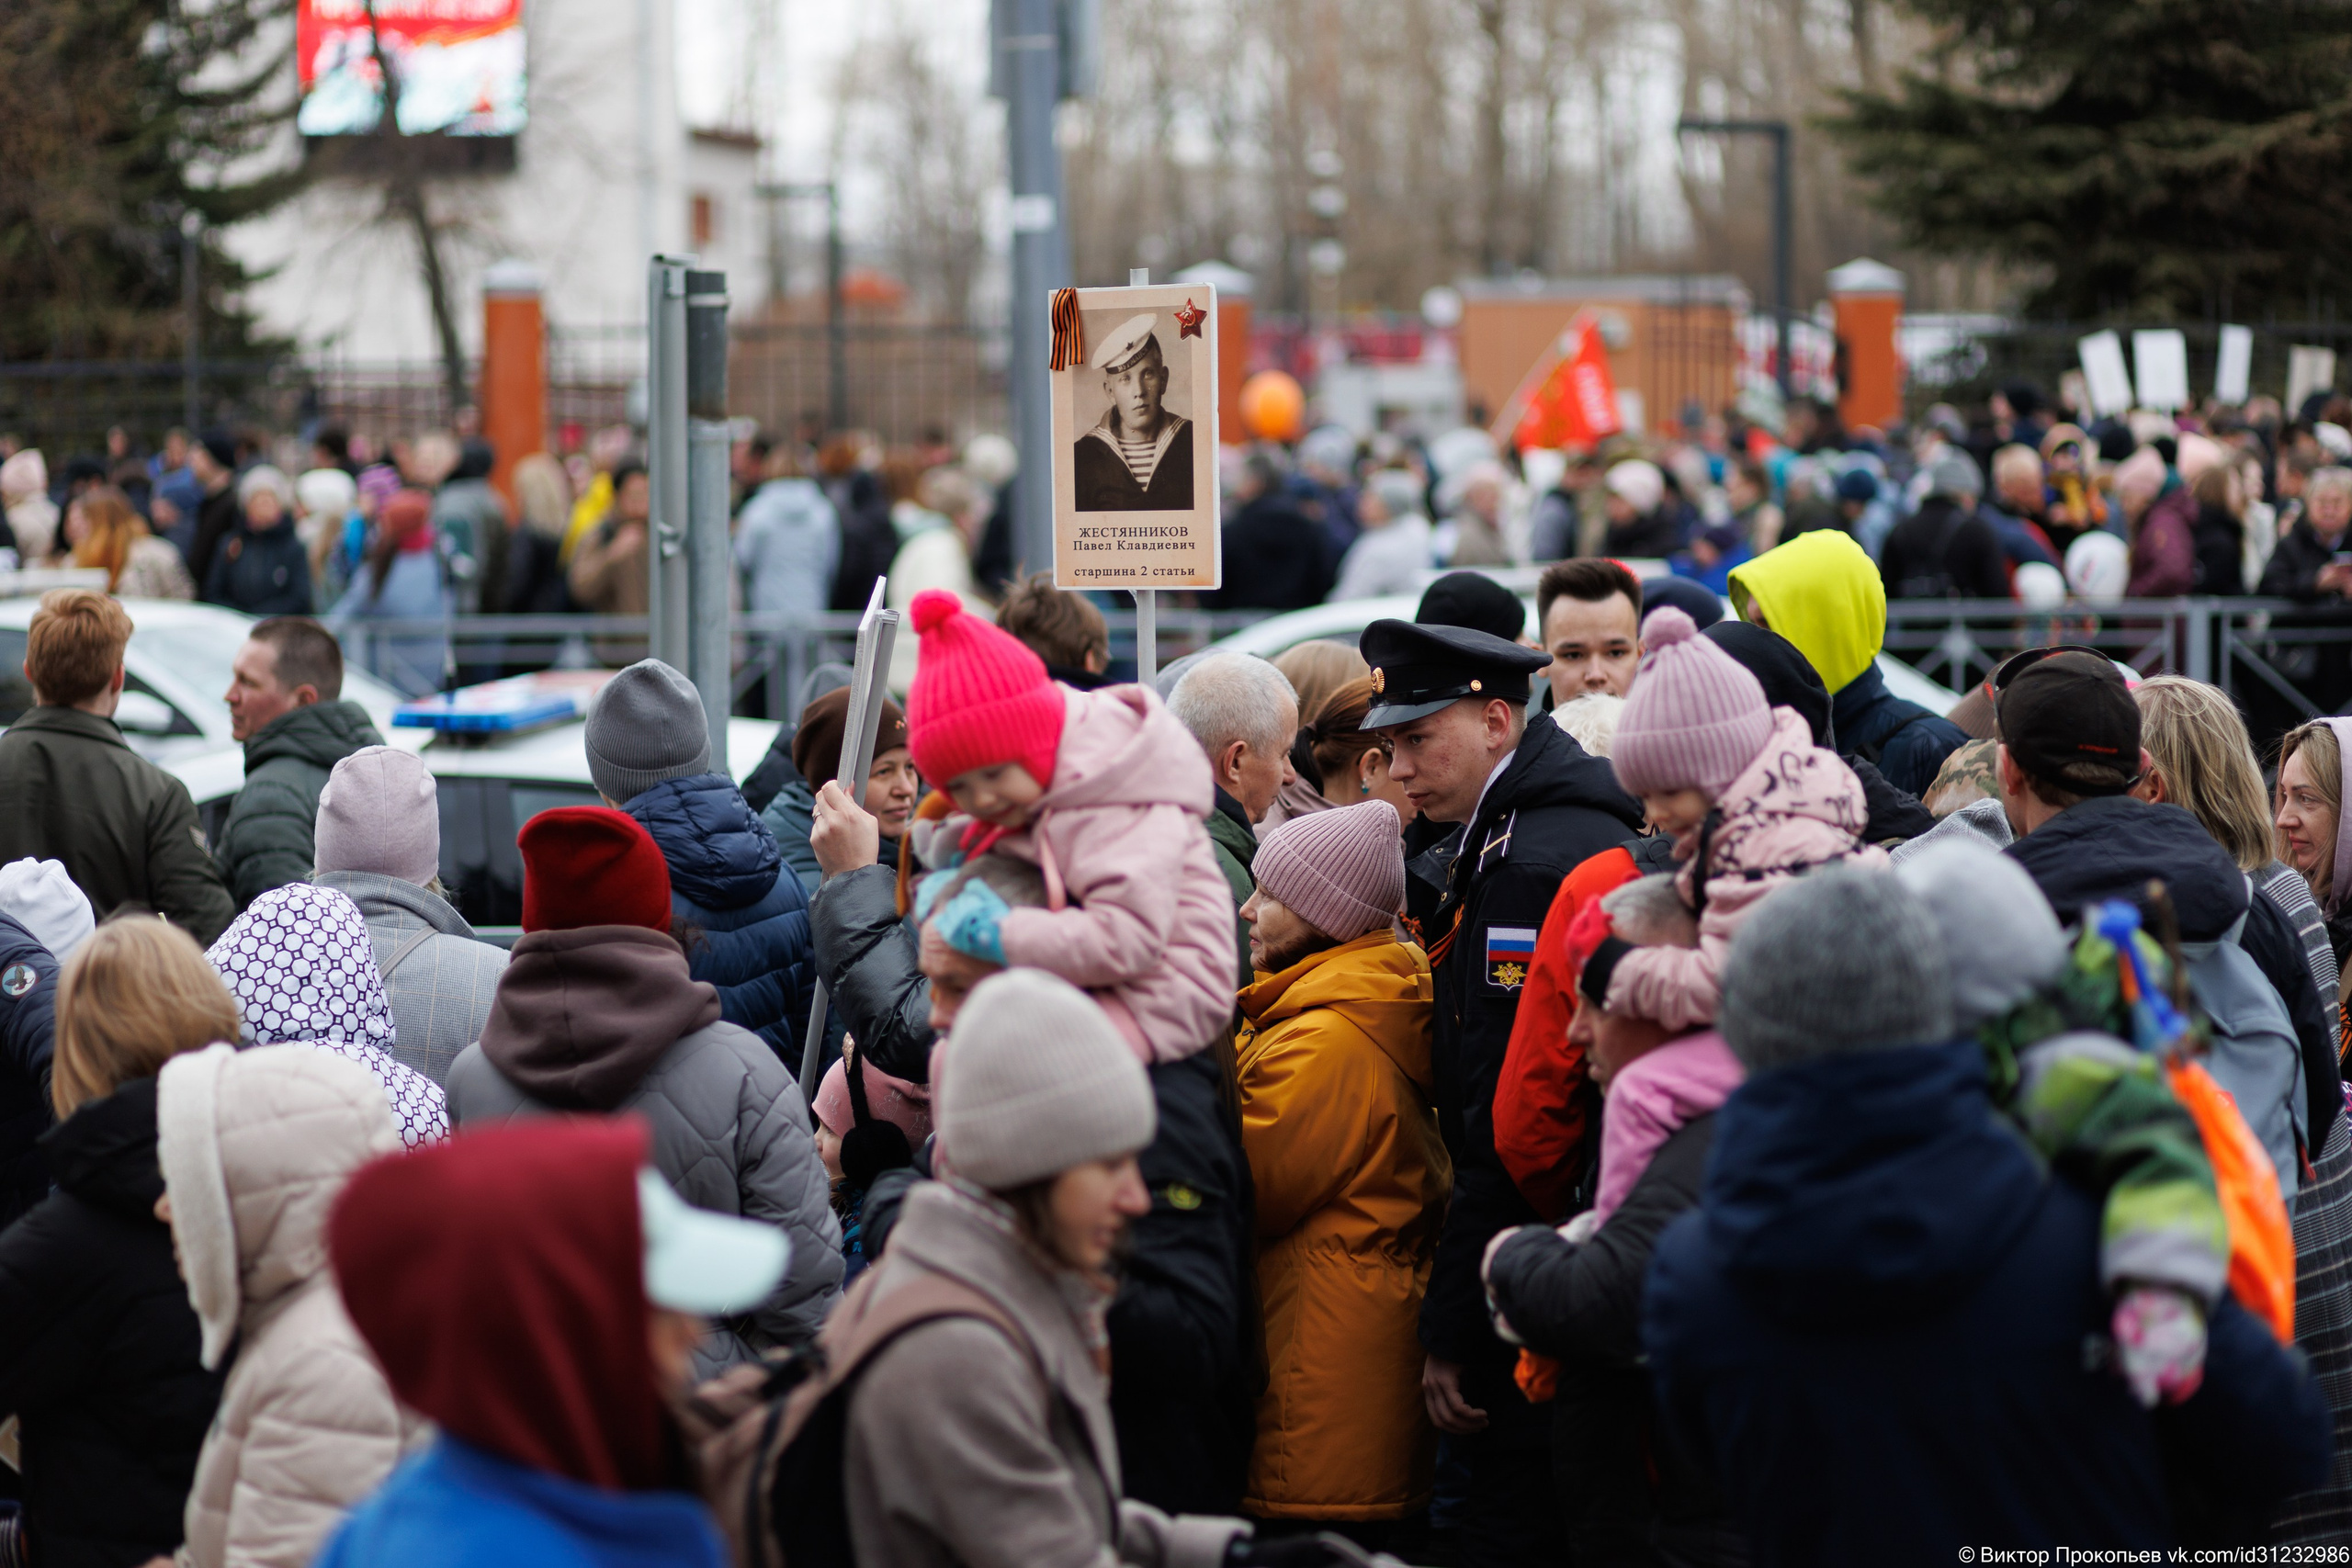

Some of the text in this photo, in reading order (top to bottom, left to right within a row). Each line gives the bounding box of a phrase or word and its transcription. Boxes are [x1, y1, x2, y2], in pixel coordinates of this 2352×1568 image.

[1117, 346, 1148, 372] МУРМАНС
[1079, 526, 1189, 538] ЖЕСТЯННИКОВ
[1073, 539, 1195, 551] Павел Клавдиевич
[1074, 566, 1195, 579] старшина 2 статьи
